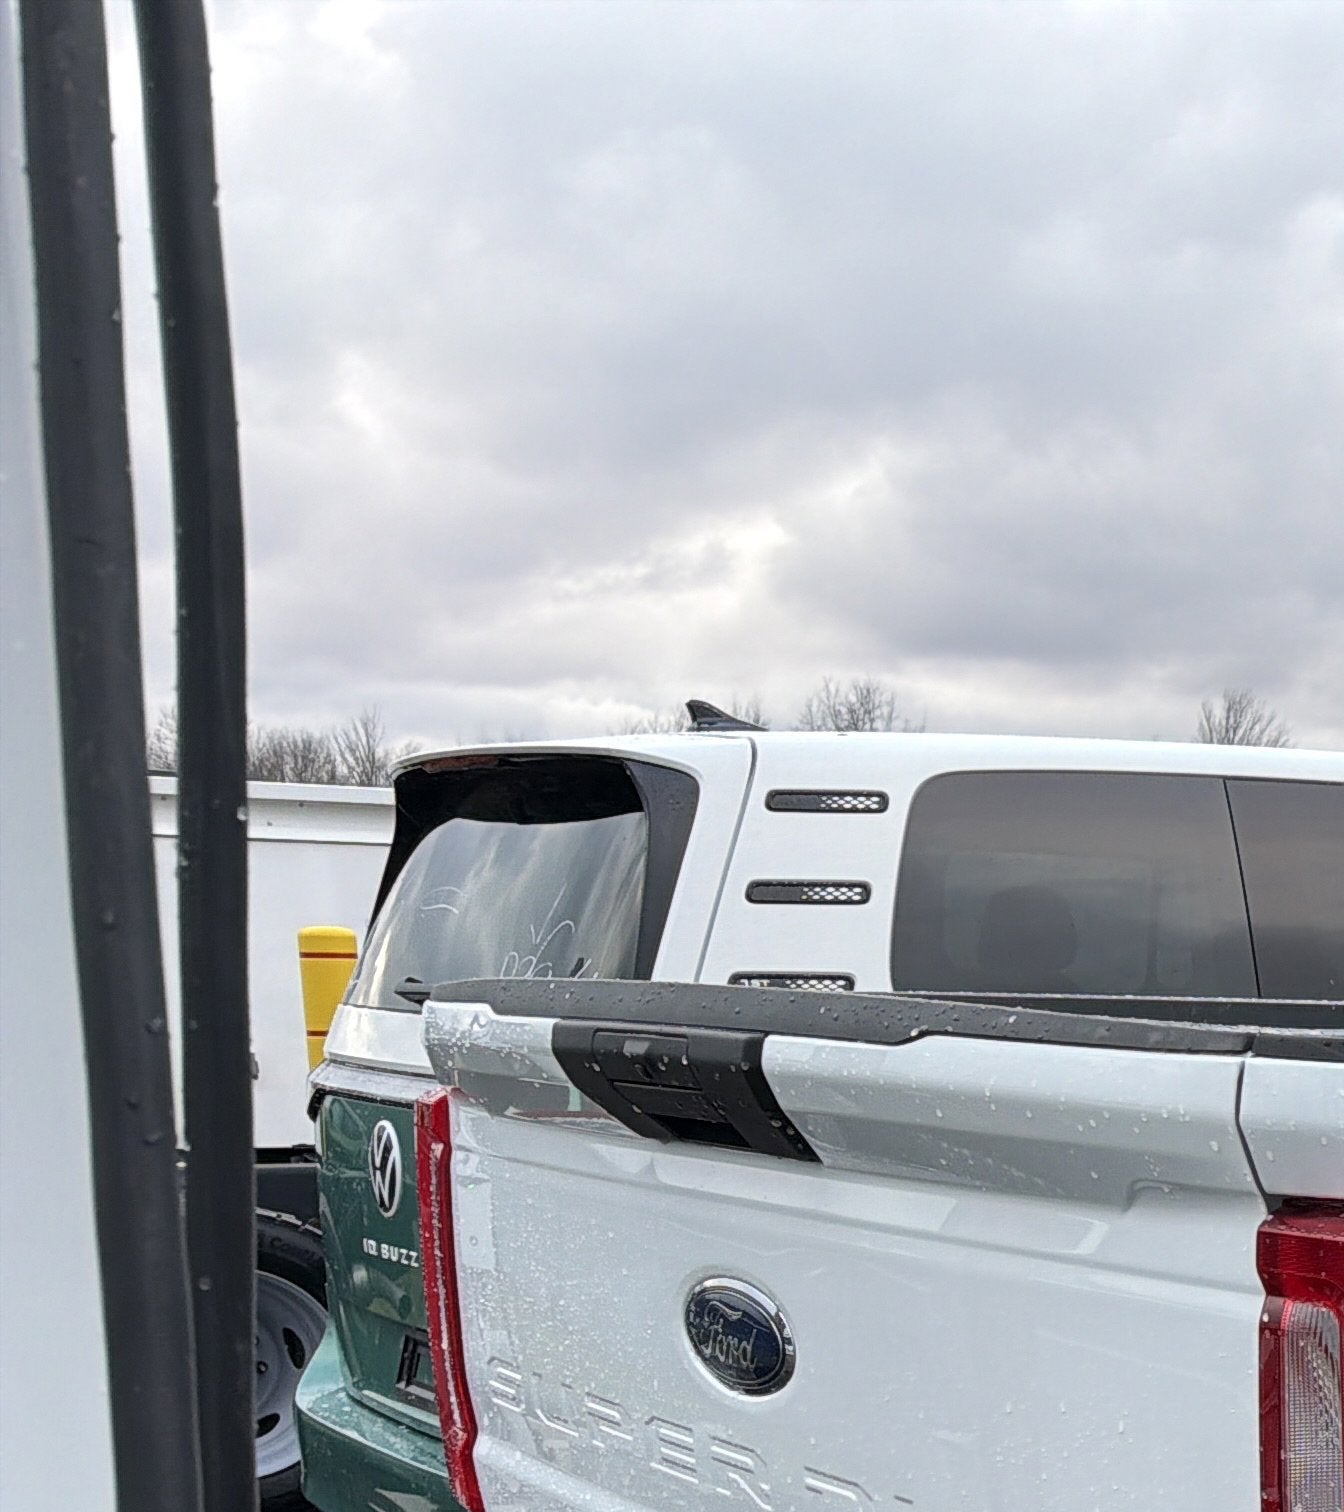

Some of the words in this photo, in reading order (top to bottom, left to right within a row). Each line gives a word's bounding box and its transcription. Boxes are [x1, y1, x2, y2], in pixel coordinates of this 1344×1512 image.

[381, 1244, 419, 1267] BUZZ
[701, 1300, 758, 1372] Ford
[487, 1355, 773, 1511] SUPER
